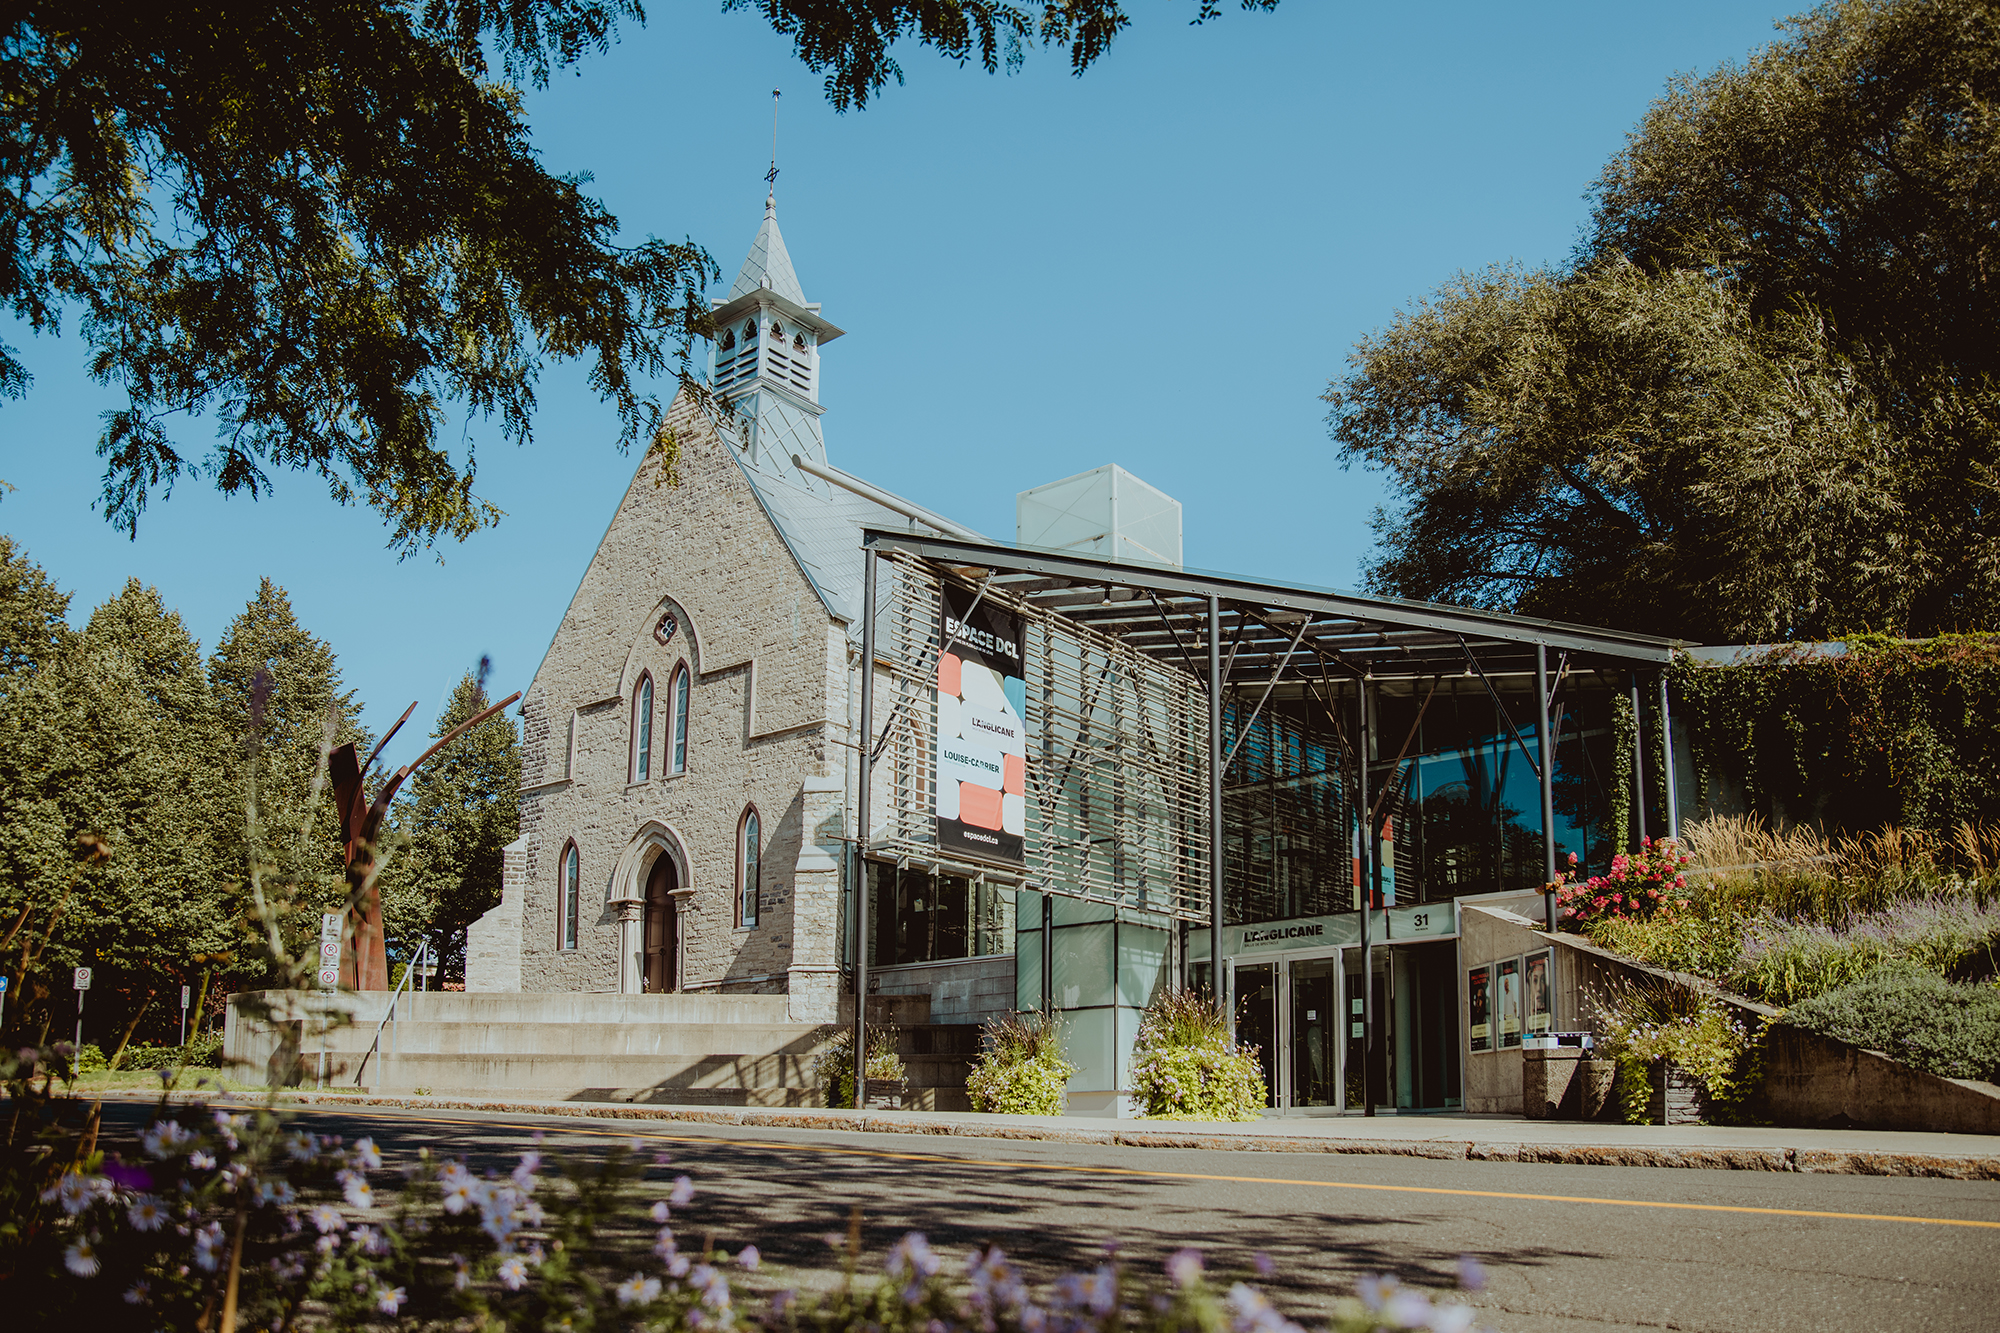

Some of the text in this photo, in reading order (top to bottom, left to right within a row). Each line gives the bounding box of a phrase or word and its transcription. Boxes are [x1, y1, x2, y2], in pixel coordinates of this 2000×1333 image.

[945, 616, 994, 650] ESPACE
[995, 636, 1020, 660] DCL
[963, 831, 999, 845] espacedcl.ca
[329, 916, 337, 926] P
[1413, 913, 1429, 927] 31
[1244, 924, 1324, 943] L'ANGLICANE
